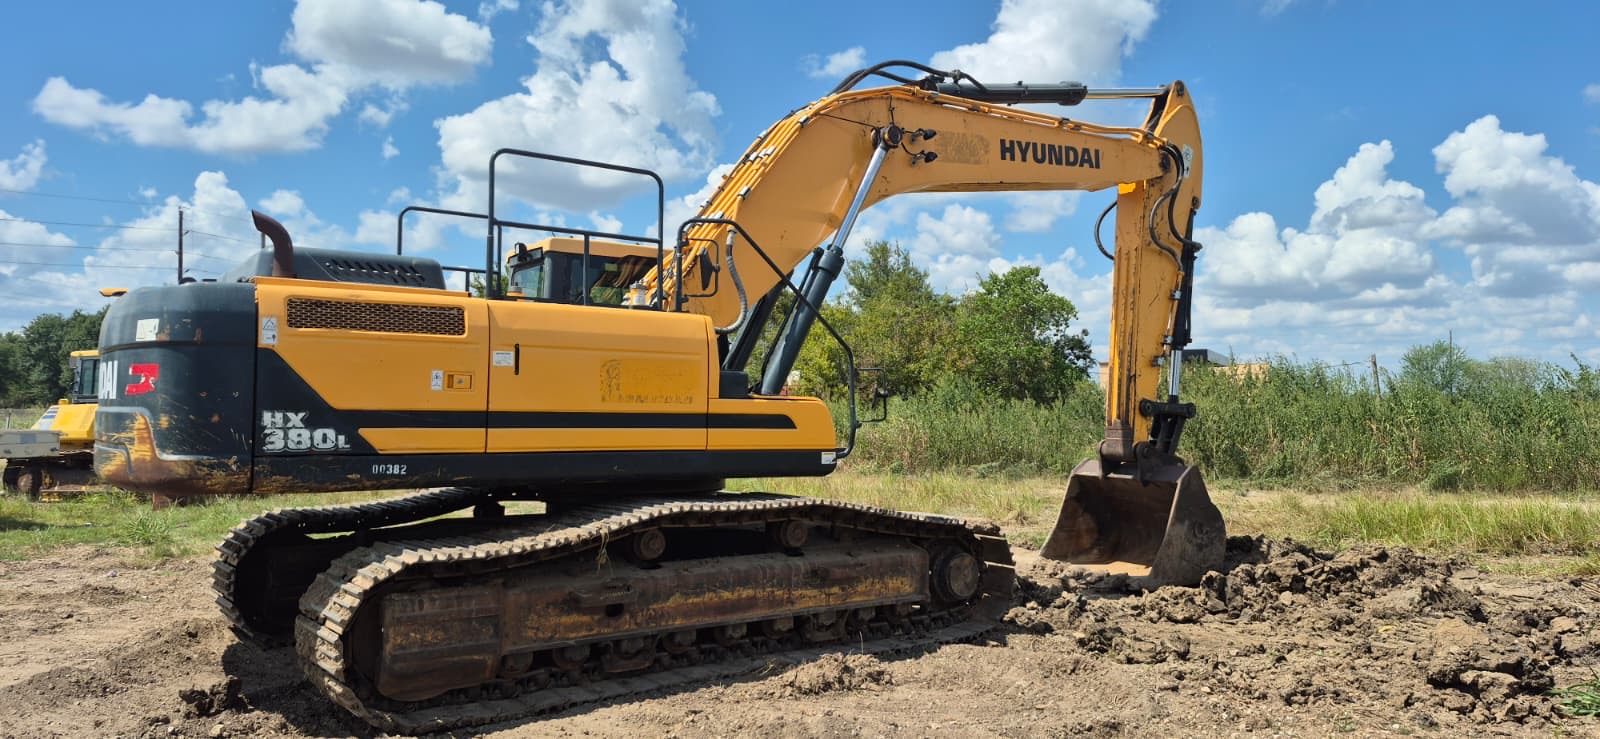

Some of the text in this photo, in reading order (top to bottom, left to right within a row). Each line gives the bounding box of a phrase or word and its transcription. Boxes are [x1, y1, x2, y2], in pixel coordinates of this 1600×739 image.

[1000, 138, 1101, 169] HYUNDAI
[262, 410, 306, 428] HX
[372, 464, 408, 475] 00382
